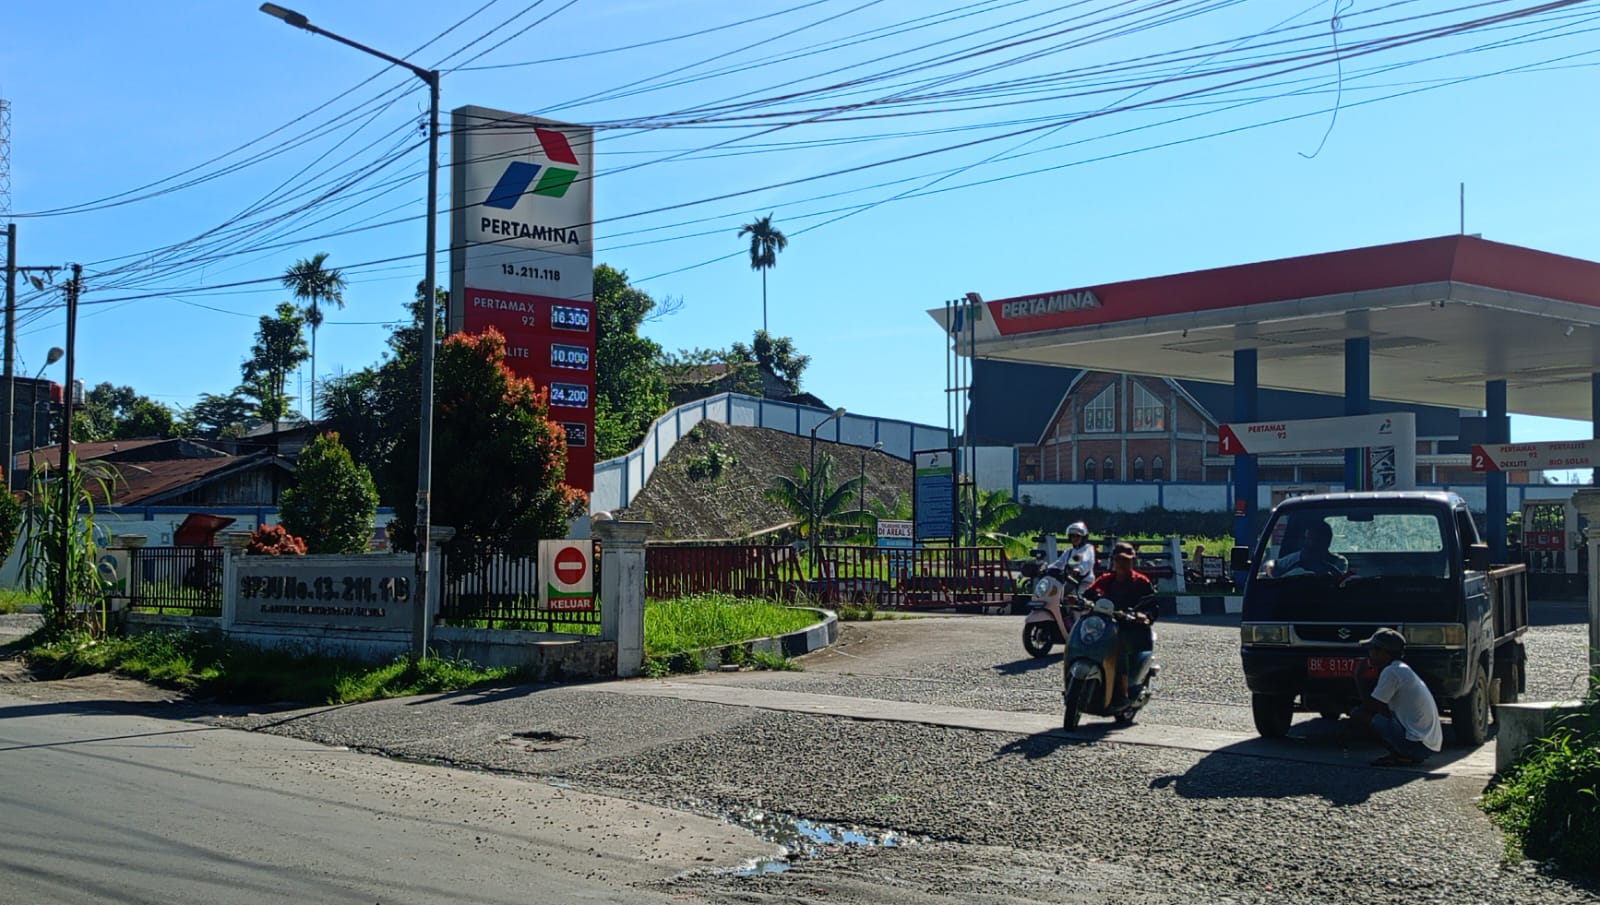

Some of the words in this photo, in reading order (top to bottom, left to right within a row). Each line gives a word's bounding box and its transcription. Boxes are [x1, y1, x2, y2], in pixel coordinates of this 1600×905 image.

[481, 217, 580, 245] PERTAMINA
[502, 263, 561, 281] 13.211.118
[473, 297, 535, 313] PERTAMAX
[1002, 290, 1102, 319] PERTAMINA
[521, 315, 535, 327] 92
[553, 311, 588, 325] 16.300
[507, 346, 529, 358] LITE
[553, 350, 588, 364] 10.000
[552, 388, 586, 401] 24.200
[1248, 424, 1286, 433] PERTAMAX
[1277, 432, 1287, 440] 92
[1222, 436, 1230, 450] 1
[1475, 455, 1484, 468] 2
[550, 599, 591, 609] KELUAR
[1329, 658, 1355, 671] 8137
